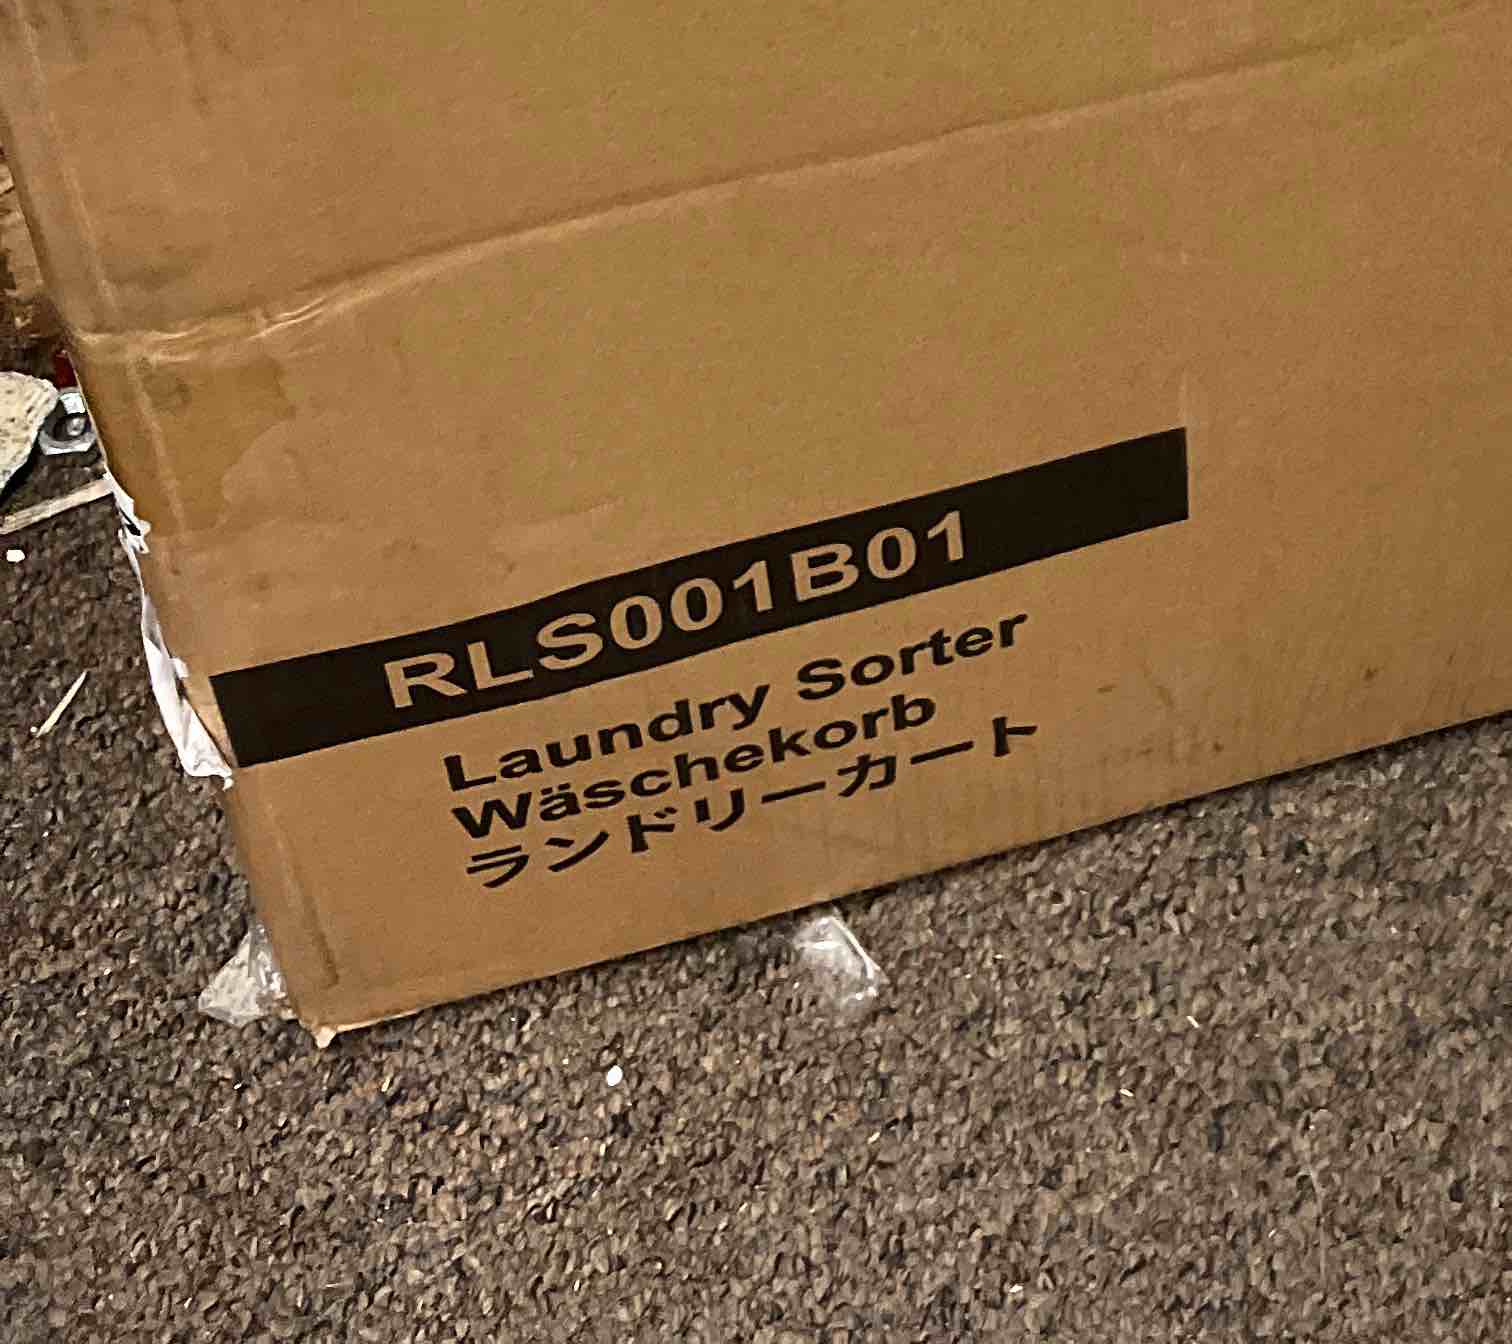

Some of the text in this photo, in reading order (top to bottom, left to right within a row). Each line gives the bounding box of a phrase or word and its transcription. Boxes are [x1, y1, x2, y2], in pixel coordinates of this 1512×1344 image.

[385, 511, 966, 708] RLS001B01
[443, 613, 1029, 792] Laundry Sorter
[451, 693, 936, 839] Wäschekorb
[466, 716, 1038, 889] ランドリーカート
